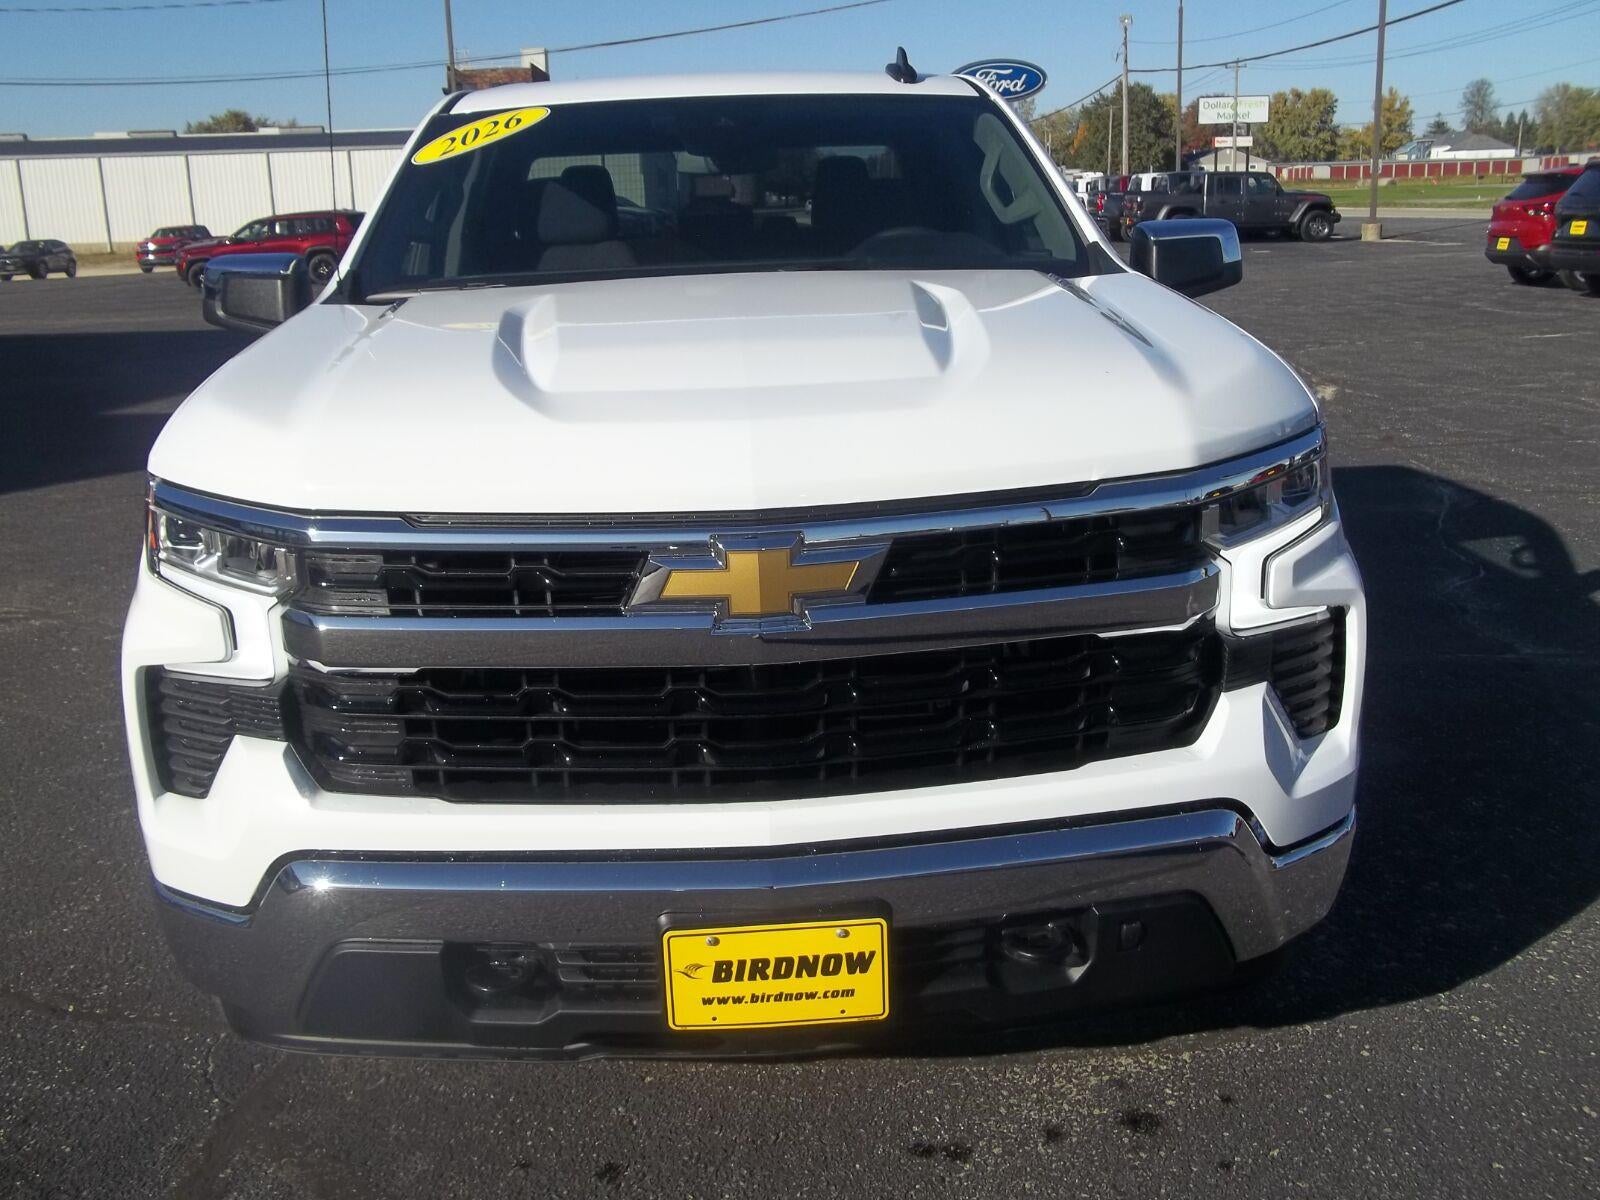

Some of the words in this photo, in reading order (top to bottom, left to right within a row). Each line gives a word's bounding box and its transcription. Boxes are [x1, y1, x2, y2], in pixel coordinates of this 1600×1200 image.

[976, 69, 1027, 92] Ford
[1202, 101, 1230, 110] Dollar
[440, 111, 522, 157] 2026
[711, 950, 877, 984] BIRDNOW
[701, 988, 856, 1006] www.birdnow.com
